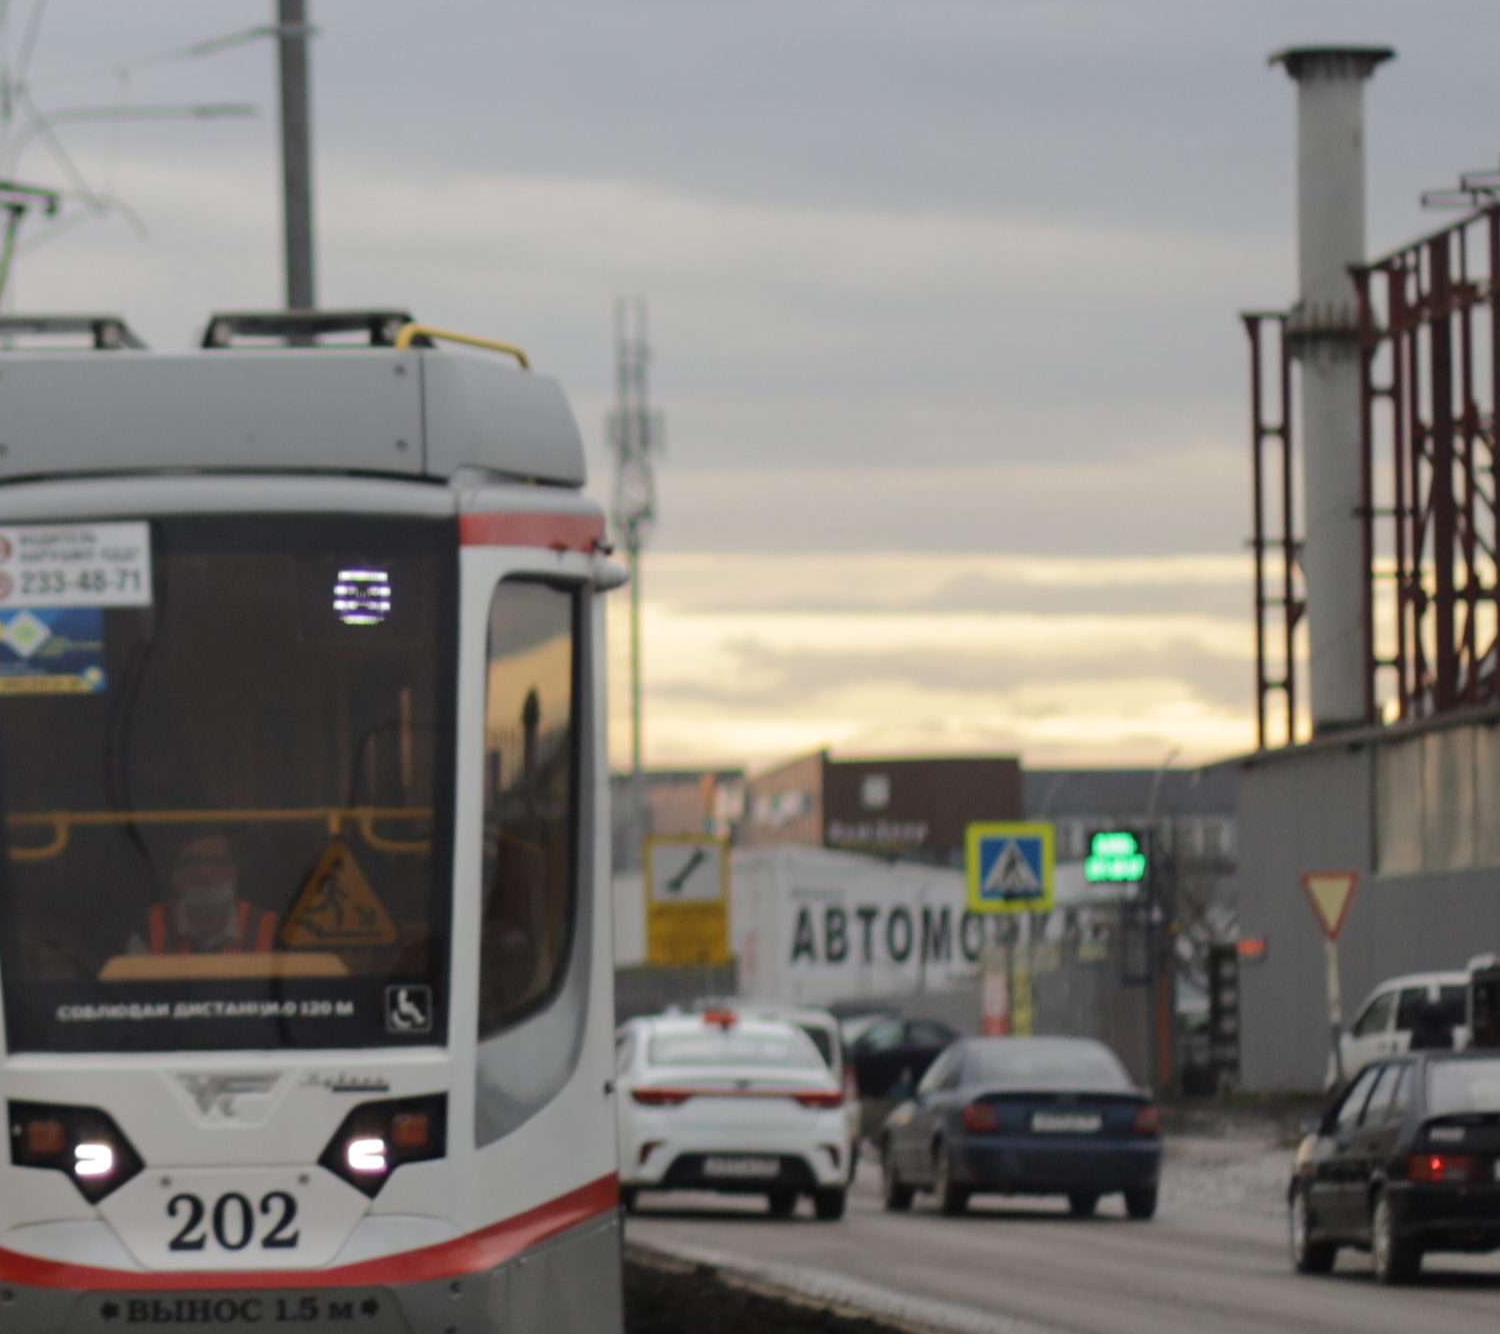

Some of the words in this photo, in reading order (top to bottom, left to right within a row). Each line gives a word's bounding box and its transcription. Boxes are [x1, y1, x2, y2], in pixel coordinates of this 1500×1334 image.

[20, 567, 142, 595] 233-48-71
[166, 1191, 300, 1251] 202
[126, 1298, 262, 1322] ВЫНОС
[273, 1296, 320, 1320] 1.5
